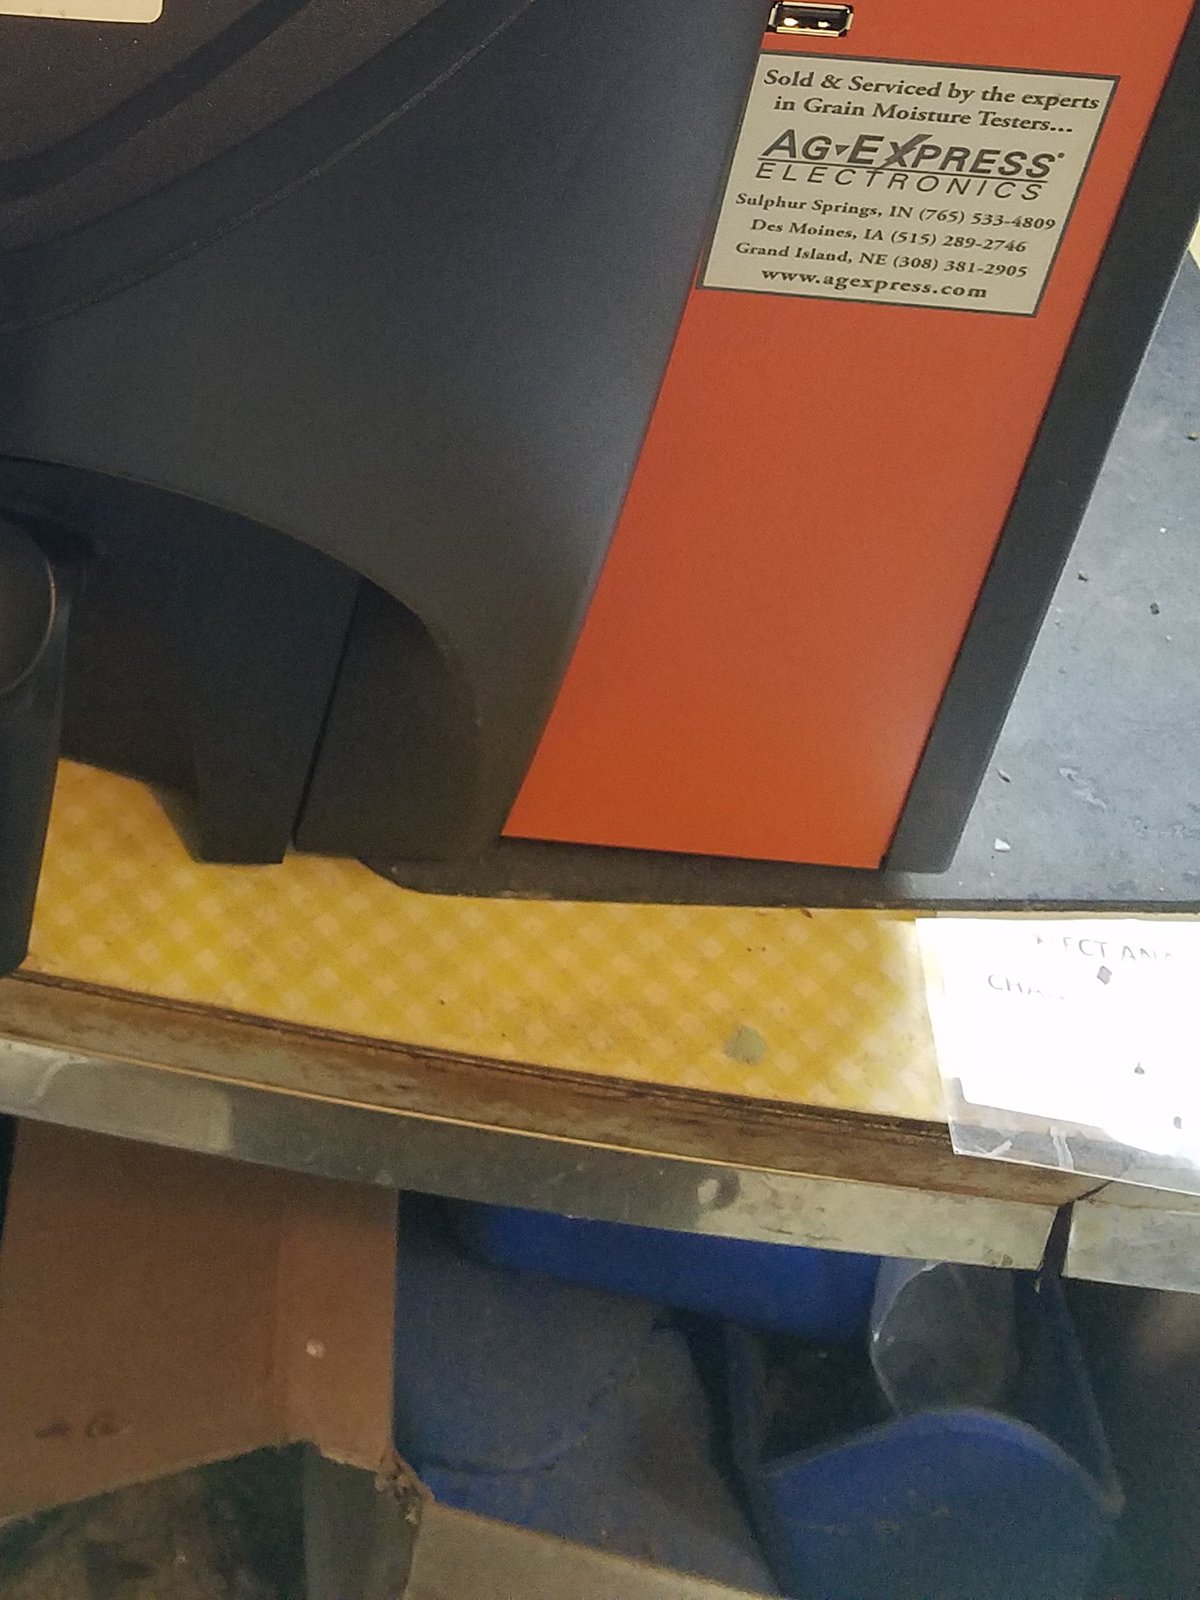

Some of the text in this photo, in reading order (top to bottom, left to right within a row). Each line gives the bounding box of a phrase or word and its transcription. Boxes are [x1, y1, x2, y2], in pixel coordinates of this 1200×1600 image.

[763, 69, 1100, 111] Sold & Serviced by the experts
[773, 96, 1073, 133] in Grain Moisture Testers...
[755, 162, 1043, 201] ELECTRONICS
[735, 192, 1057, 230] Sulphur Springs, IN (765) 533-4809
[750, 219, 1028, 253] Des Moines, IA (515) 289-2746
[735, 242, 1029, 278] Grand Island, NE (308) 381-2905
[761, 269, 988, 298] www.agexpress.com
